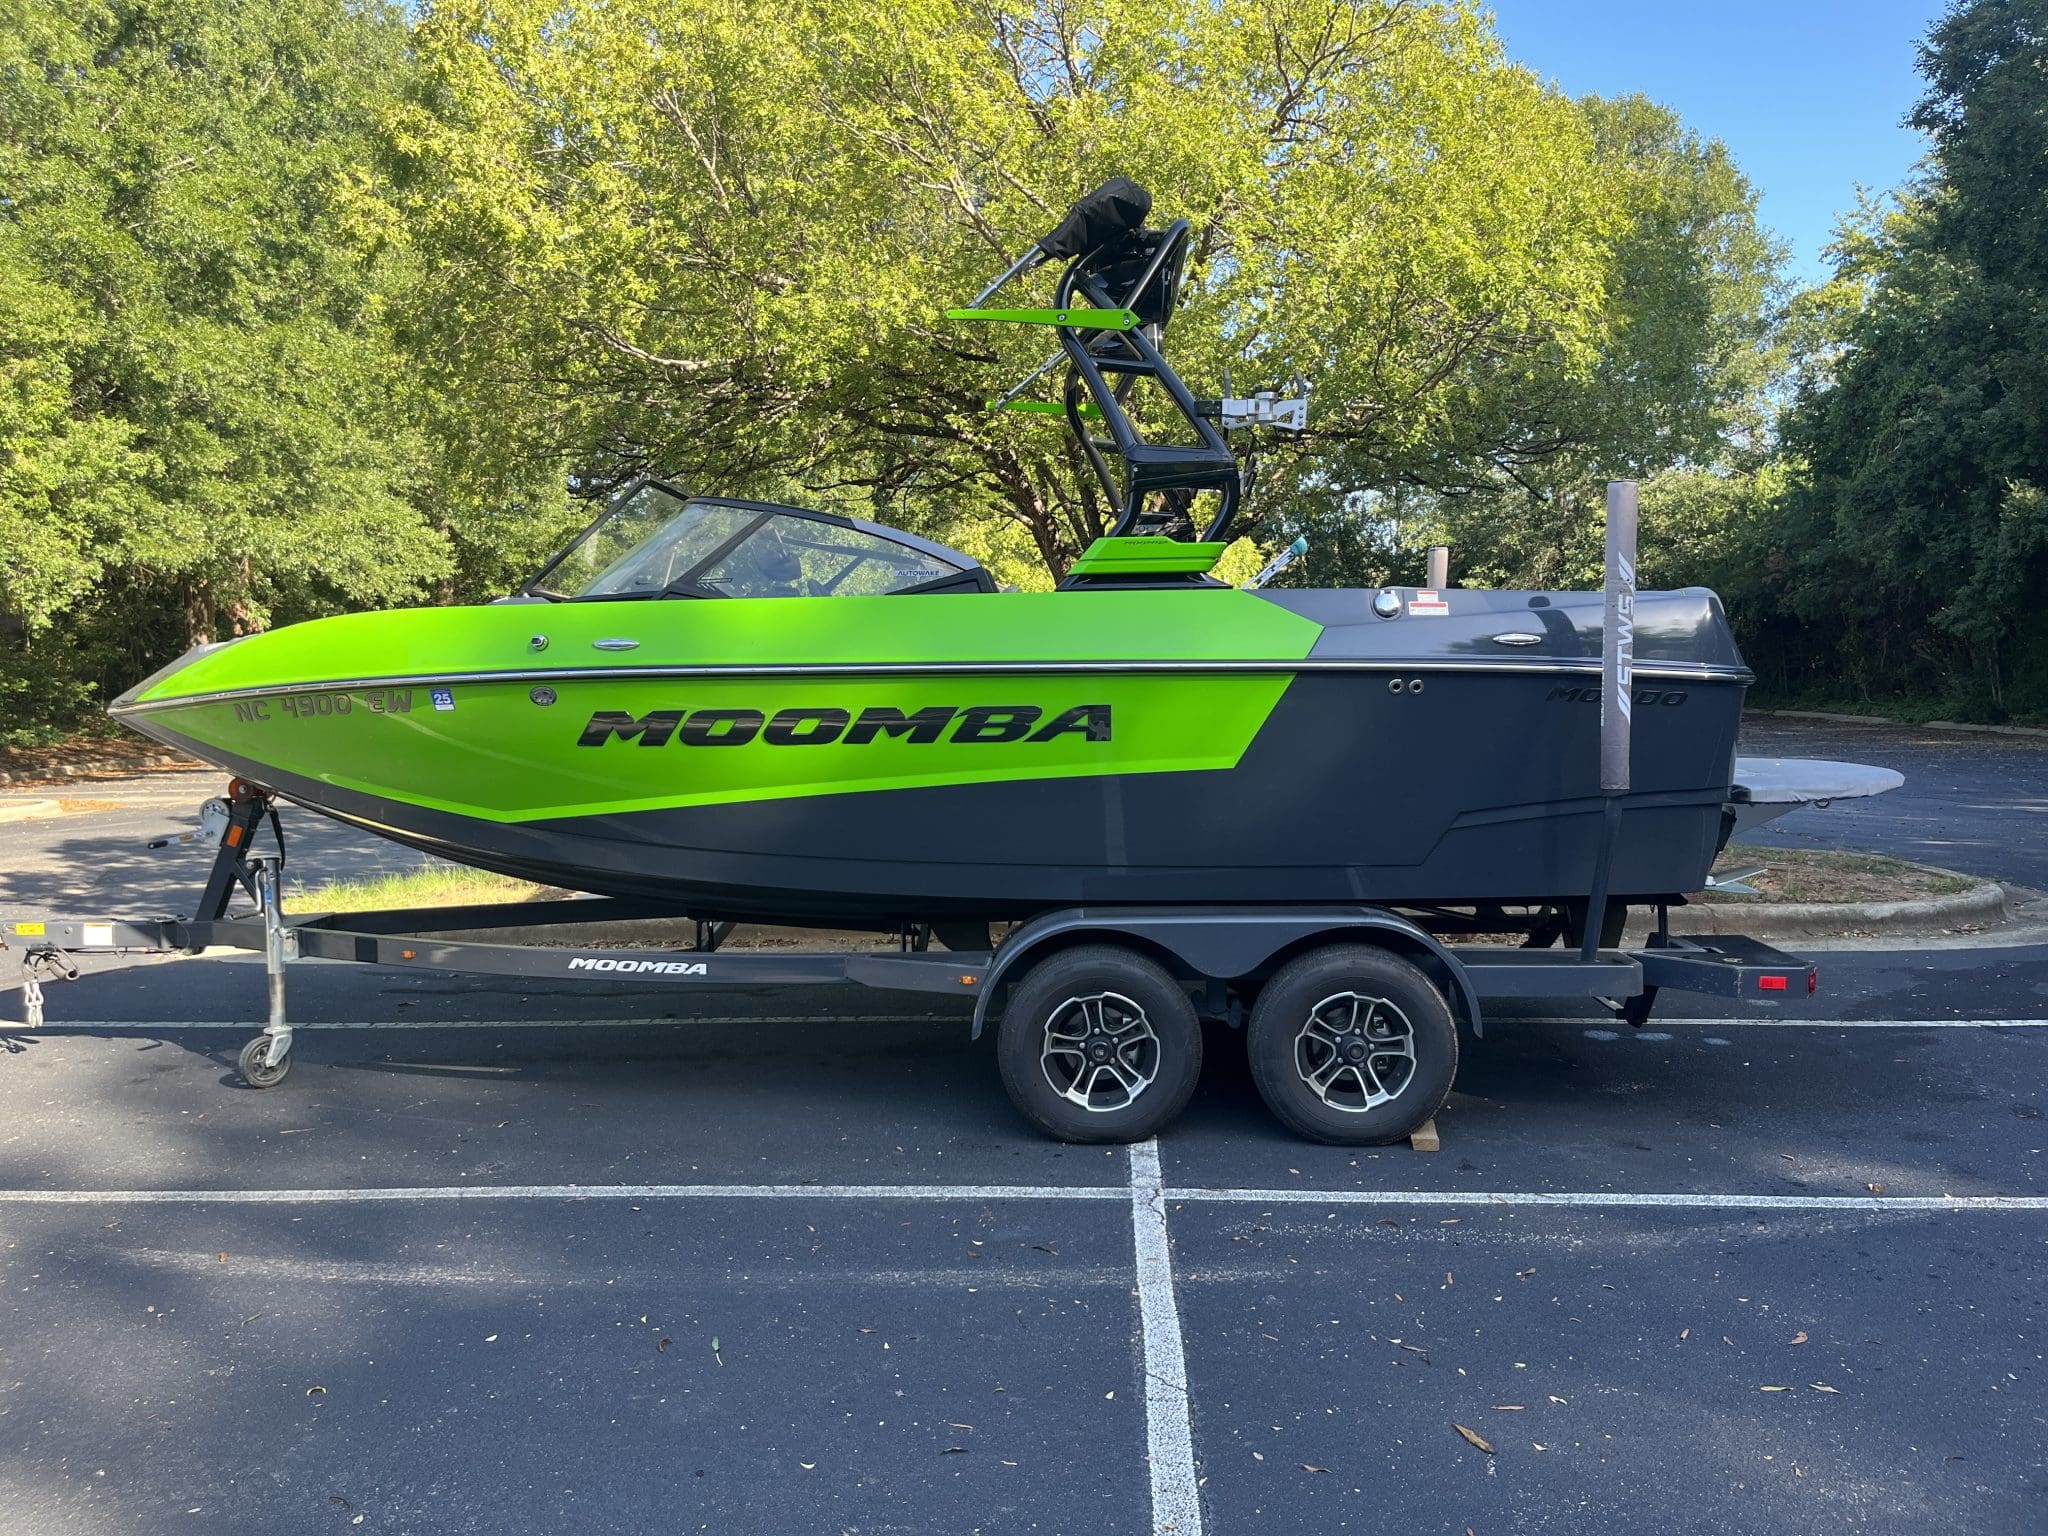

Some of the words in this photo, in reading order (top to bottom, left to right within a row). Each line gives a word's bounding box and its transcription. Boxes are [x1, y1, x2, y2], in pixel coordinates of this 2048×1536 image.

[433, 693, 451, 704] 25
[1545, 687, 1689, 705] MODO
[233, 700, 271, 722] NC
[577, 704, 1112, 747] MOOMBA
[567, 957, 708, 975] MOOMBA
